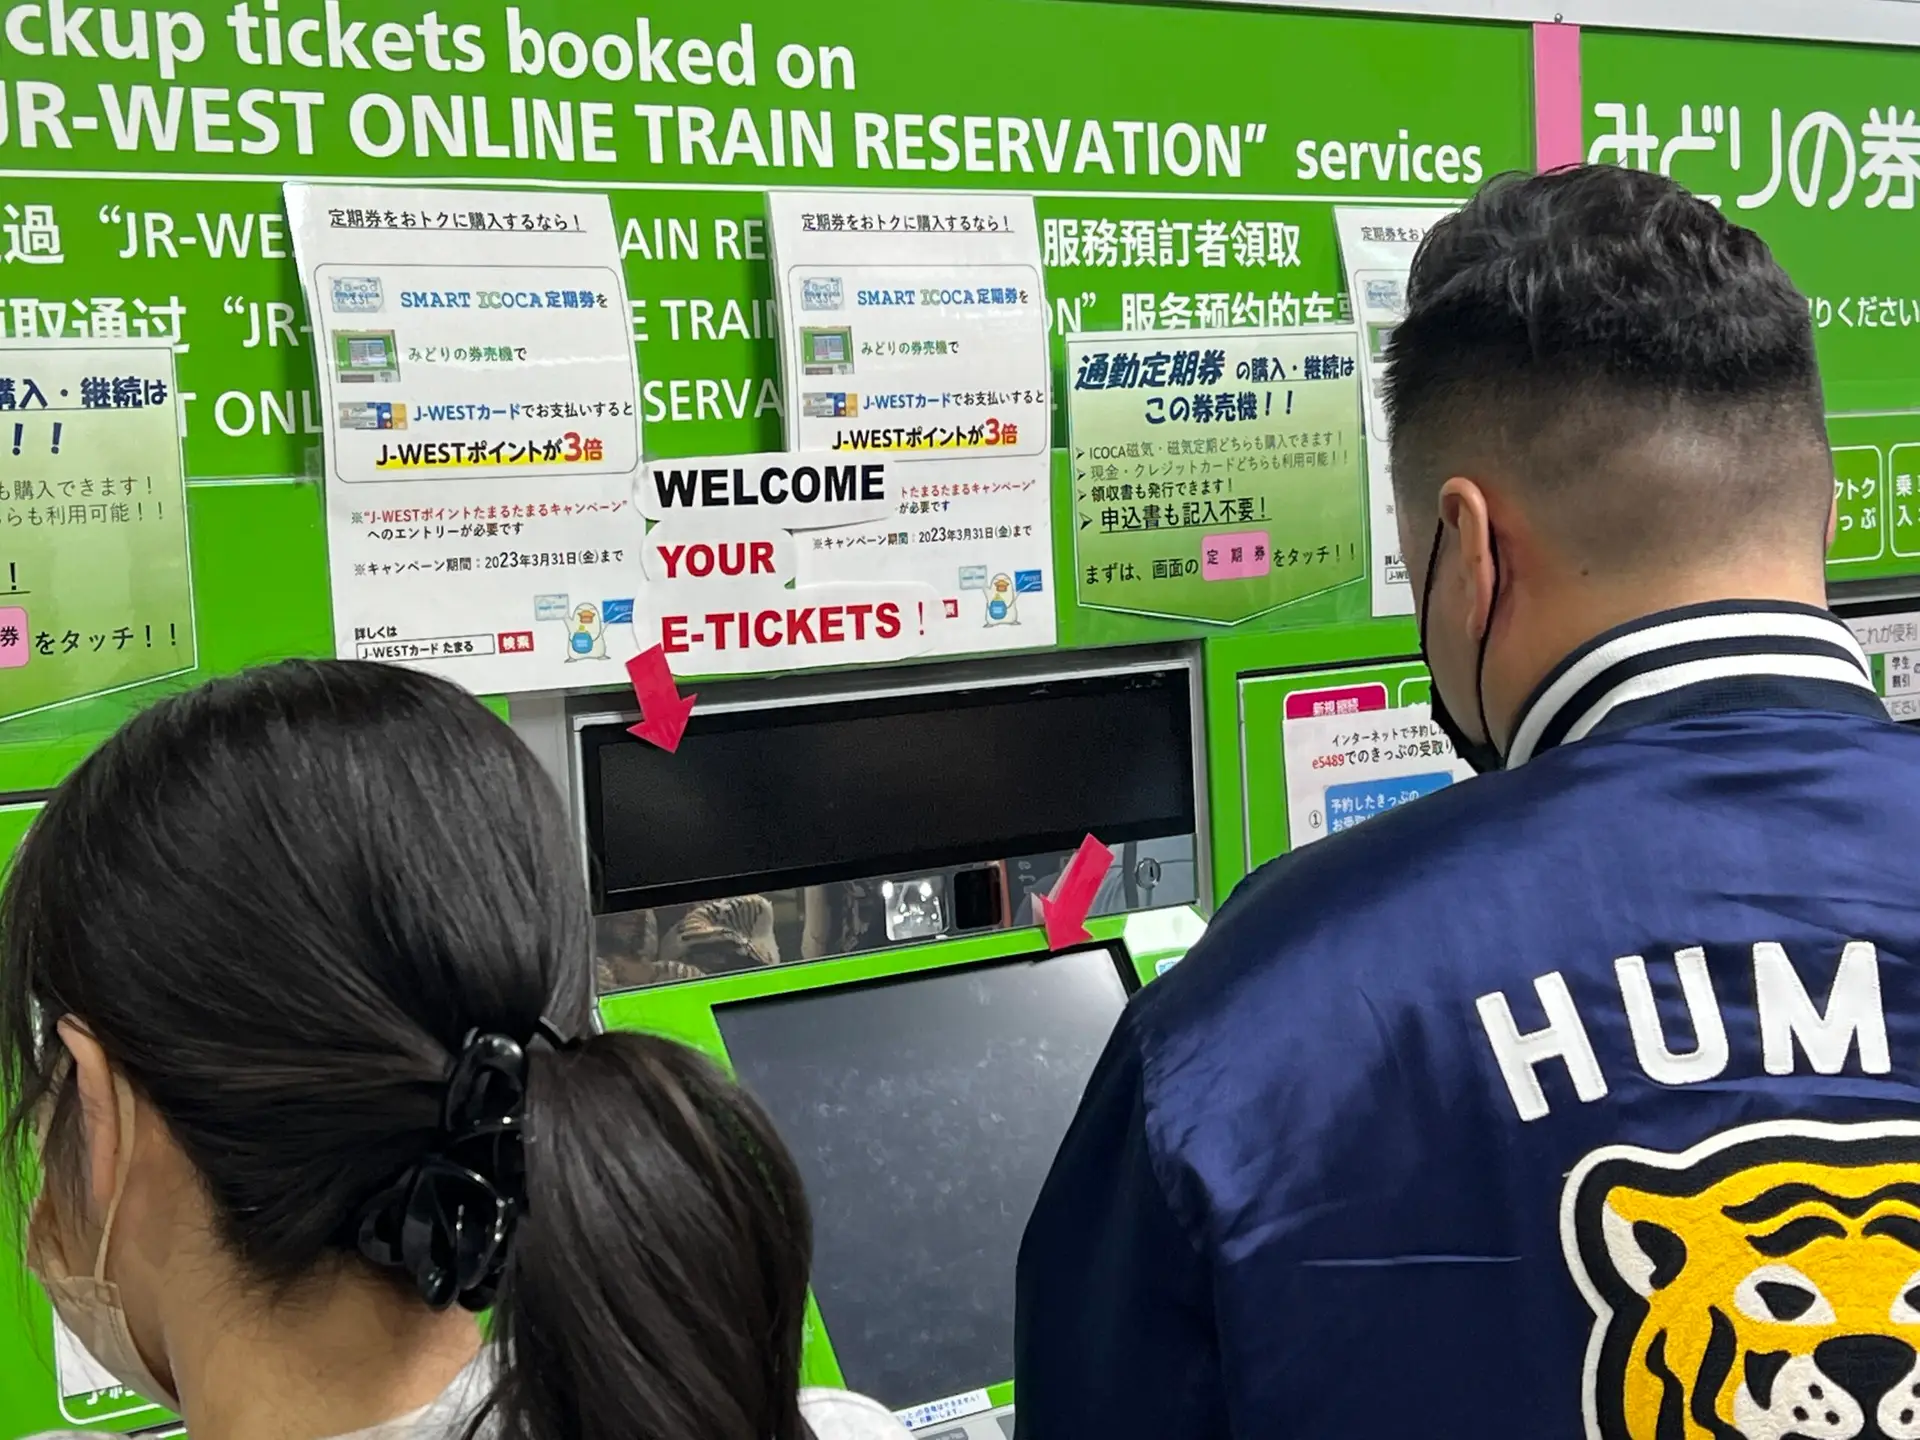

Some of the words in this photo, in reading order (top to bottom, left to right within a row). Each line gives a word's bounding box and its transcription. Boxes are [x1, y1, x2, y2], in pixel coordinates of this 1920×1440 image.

[226, 0, 485, 73] tickets
[507, 6, 756, 87] booked
[776, 43, 856, 91] on
[348, 93, 617, 165] ONLINE
[634, 105, 834, 169] TRAIN
[1296, 128, 1484, 184] services
[0, 203, 65, 264] 過
[98, 204, 298, 258] “JR-WE
[1042, 218, 1301, 268] 服務預訂者領取
[328, 208, 583, 232] 定期券をおトクに購入するなら！
[400, 292, 471, 309] SMART
[857, 290, 916, 307] SMART
[0, 296, 190, 353] 取通过
[1046, 292, 1097, 336] N”
[407, 345, 528, 363] みどりの券売機で
[860, 339, 960, 358] みどりの券売機で
[1073, 349, 1226, 391] 通勤定期券
[412, 402, 635, 422] J-WESTカードでお支払いすると
[862, 389, 1046, 411] J-WESTカードでお支払いすると
[1145, 389, 1293, 425] この券売機！！
[375, 432, 604, 467] J-WESTポイントが3倍
[831, 418, 1019, 451] J-WESTポイントが3倍
[653, 464, 885, 508] WELCOME
[1091, 478, 1233, 502] 領収書も発行できます！
[0, 501, 164, 527] らも利用可能！！
[895, 500, 950, 515] が必要です
[1101, 498, 1266, 532] 申込書も記入不要！
[656, 541, 776, 578] YOUR
[1475, 940, 1893, 1123] HUM
